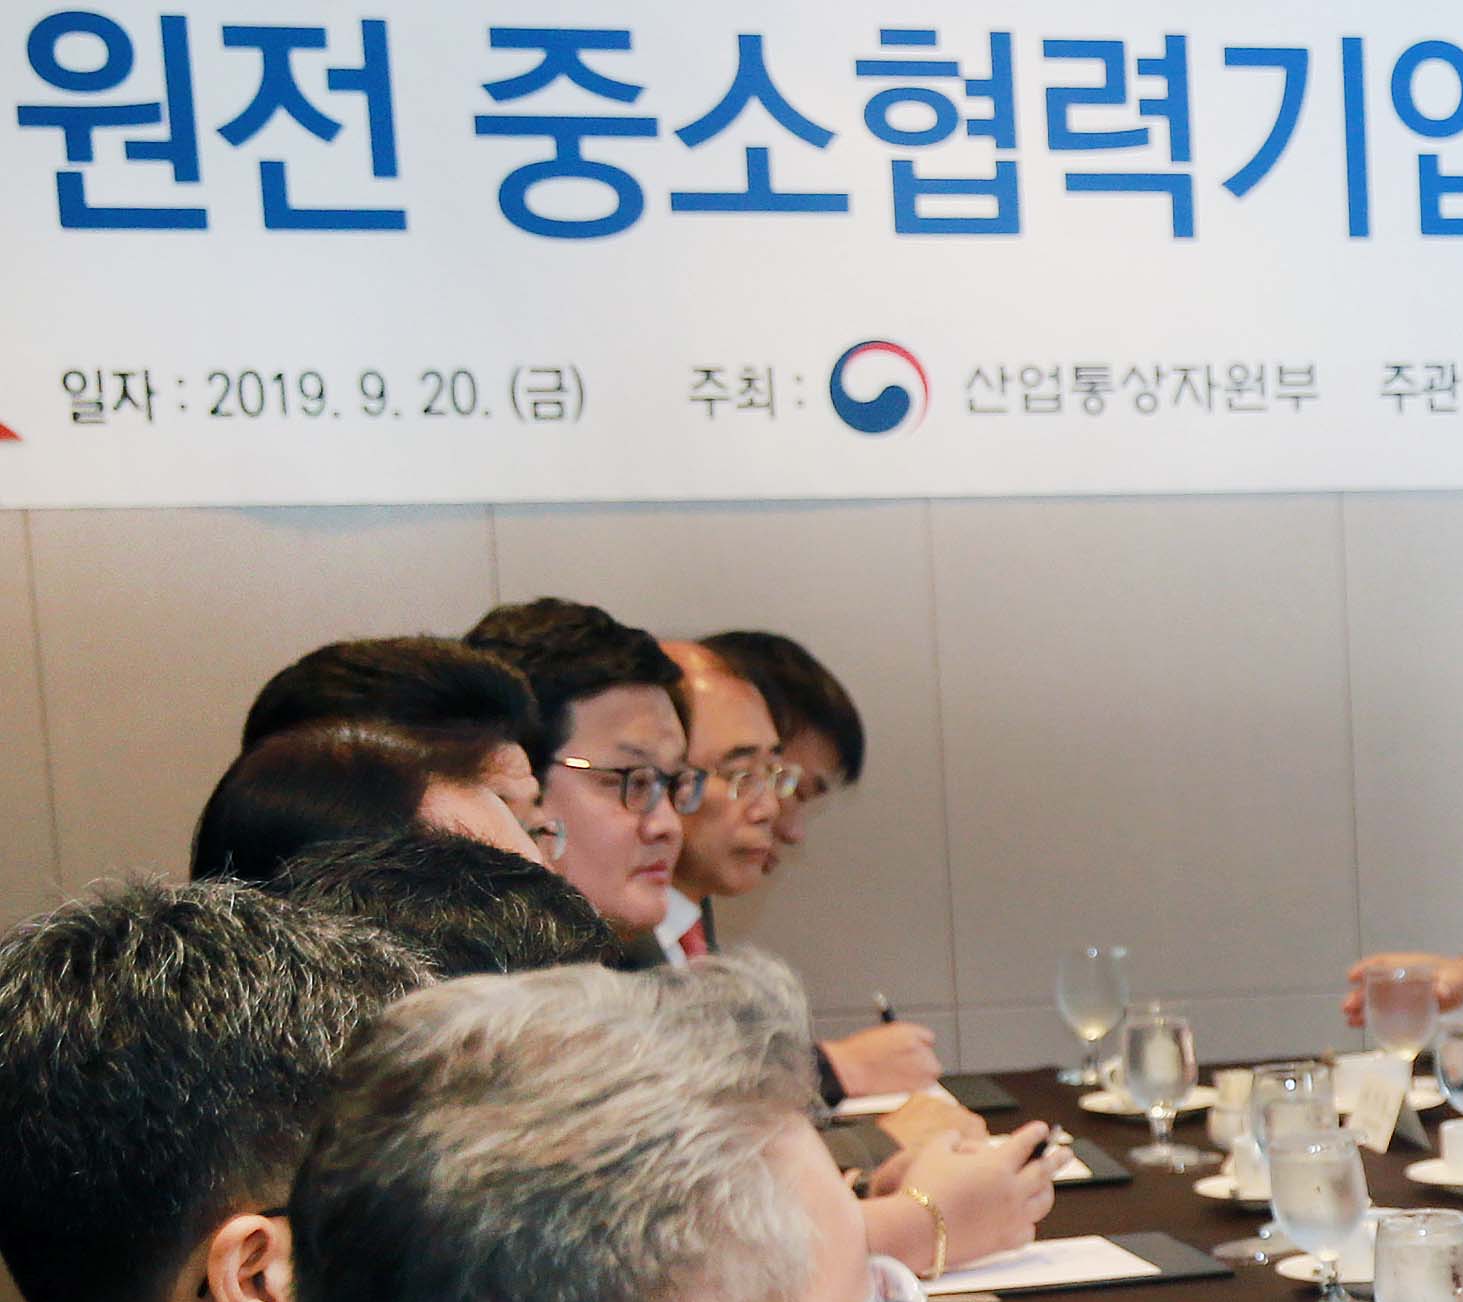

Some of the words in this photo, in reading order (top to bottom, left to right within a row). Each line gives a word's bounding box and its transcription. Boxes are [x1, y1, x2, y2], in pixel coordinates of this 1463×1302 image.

[15, 8, 409, 233] 원전
[60, 367, 156, 425] 일자
[207, 369, 342, 419] 2019.
[357, 369, 401, 418] 9.
[419, 368, 492, 418] 20.
[509, 364, 585, 424] (금)
[688, 366, 776, 420] 주최
[965, 362, 1320, 415] 산업통상자원부
[1380, 363, 1462, 413] 주관
